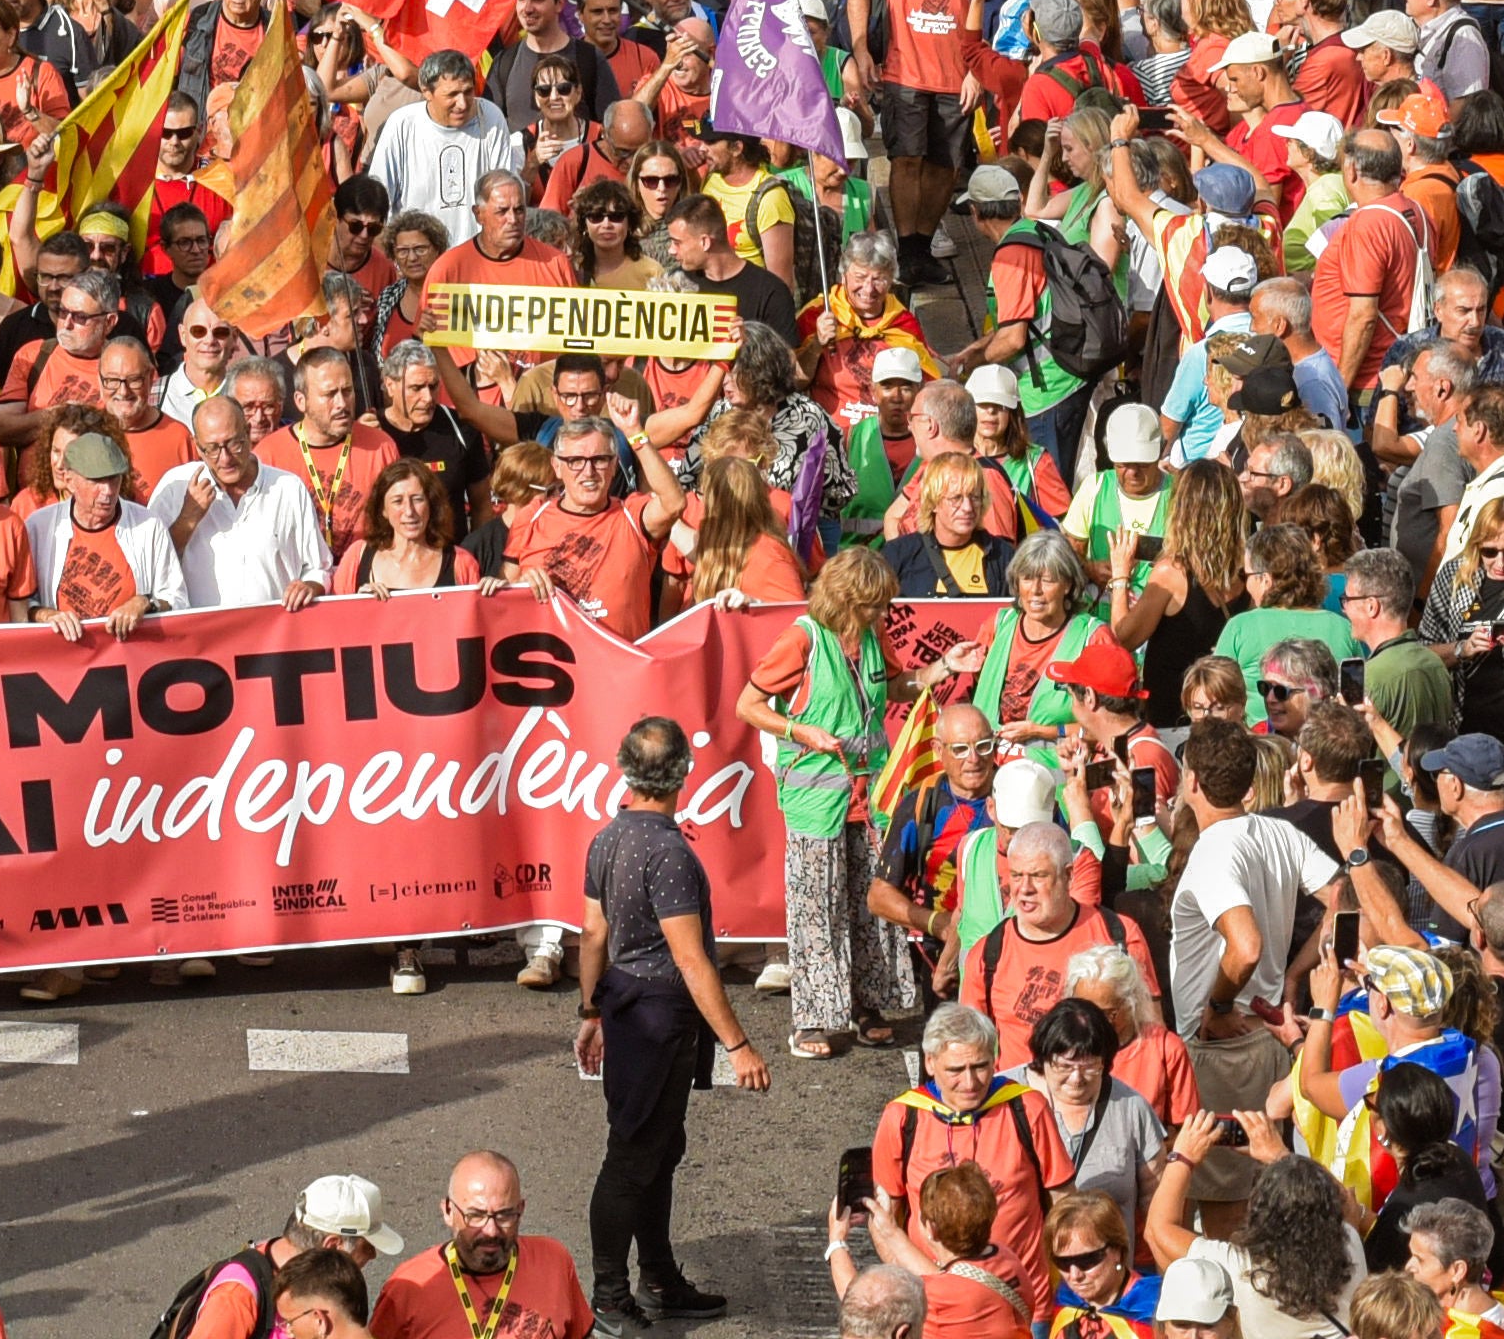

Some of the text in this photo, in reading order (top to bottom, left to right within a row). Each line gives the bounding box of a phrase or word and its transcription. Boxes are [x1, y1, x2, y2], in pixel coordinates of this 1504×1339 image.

[450, 290, 712, 345] INDEPENDÈNCIA
[0, 630, 578, 750] MOTIUS
[514, 863, 552, 886] CDR
[182, 891, 217, 904] Consell
[272, 883, 315, 899] INTER
[183, 897, 257, 913] de la República
[273, 894, 348, 912] SINDICAL
[183, 912, 226, 923] Catalana
